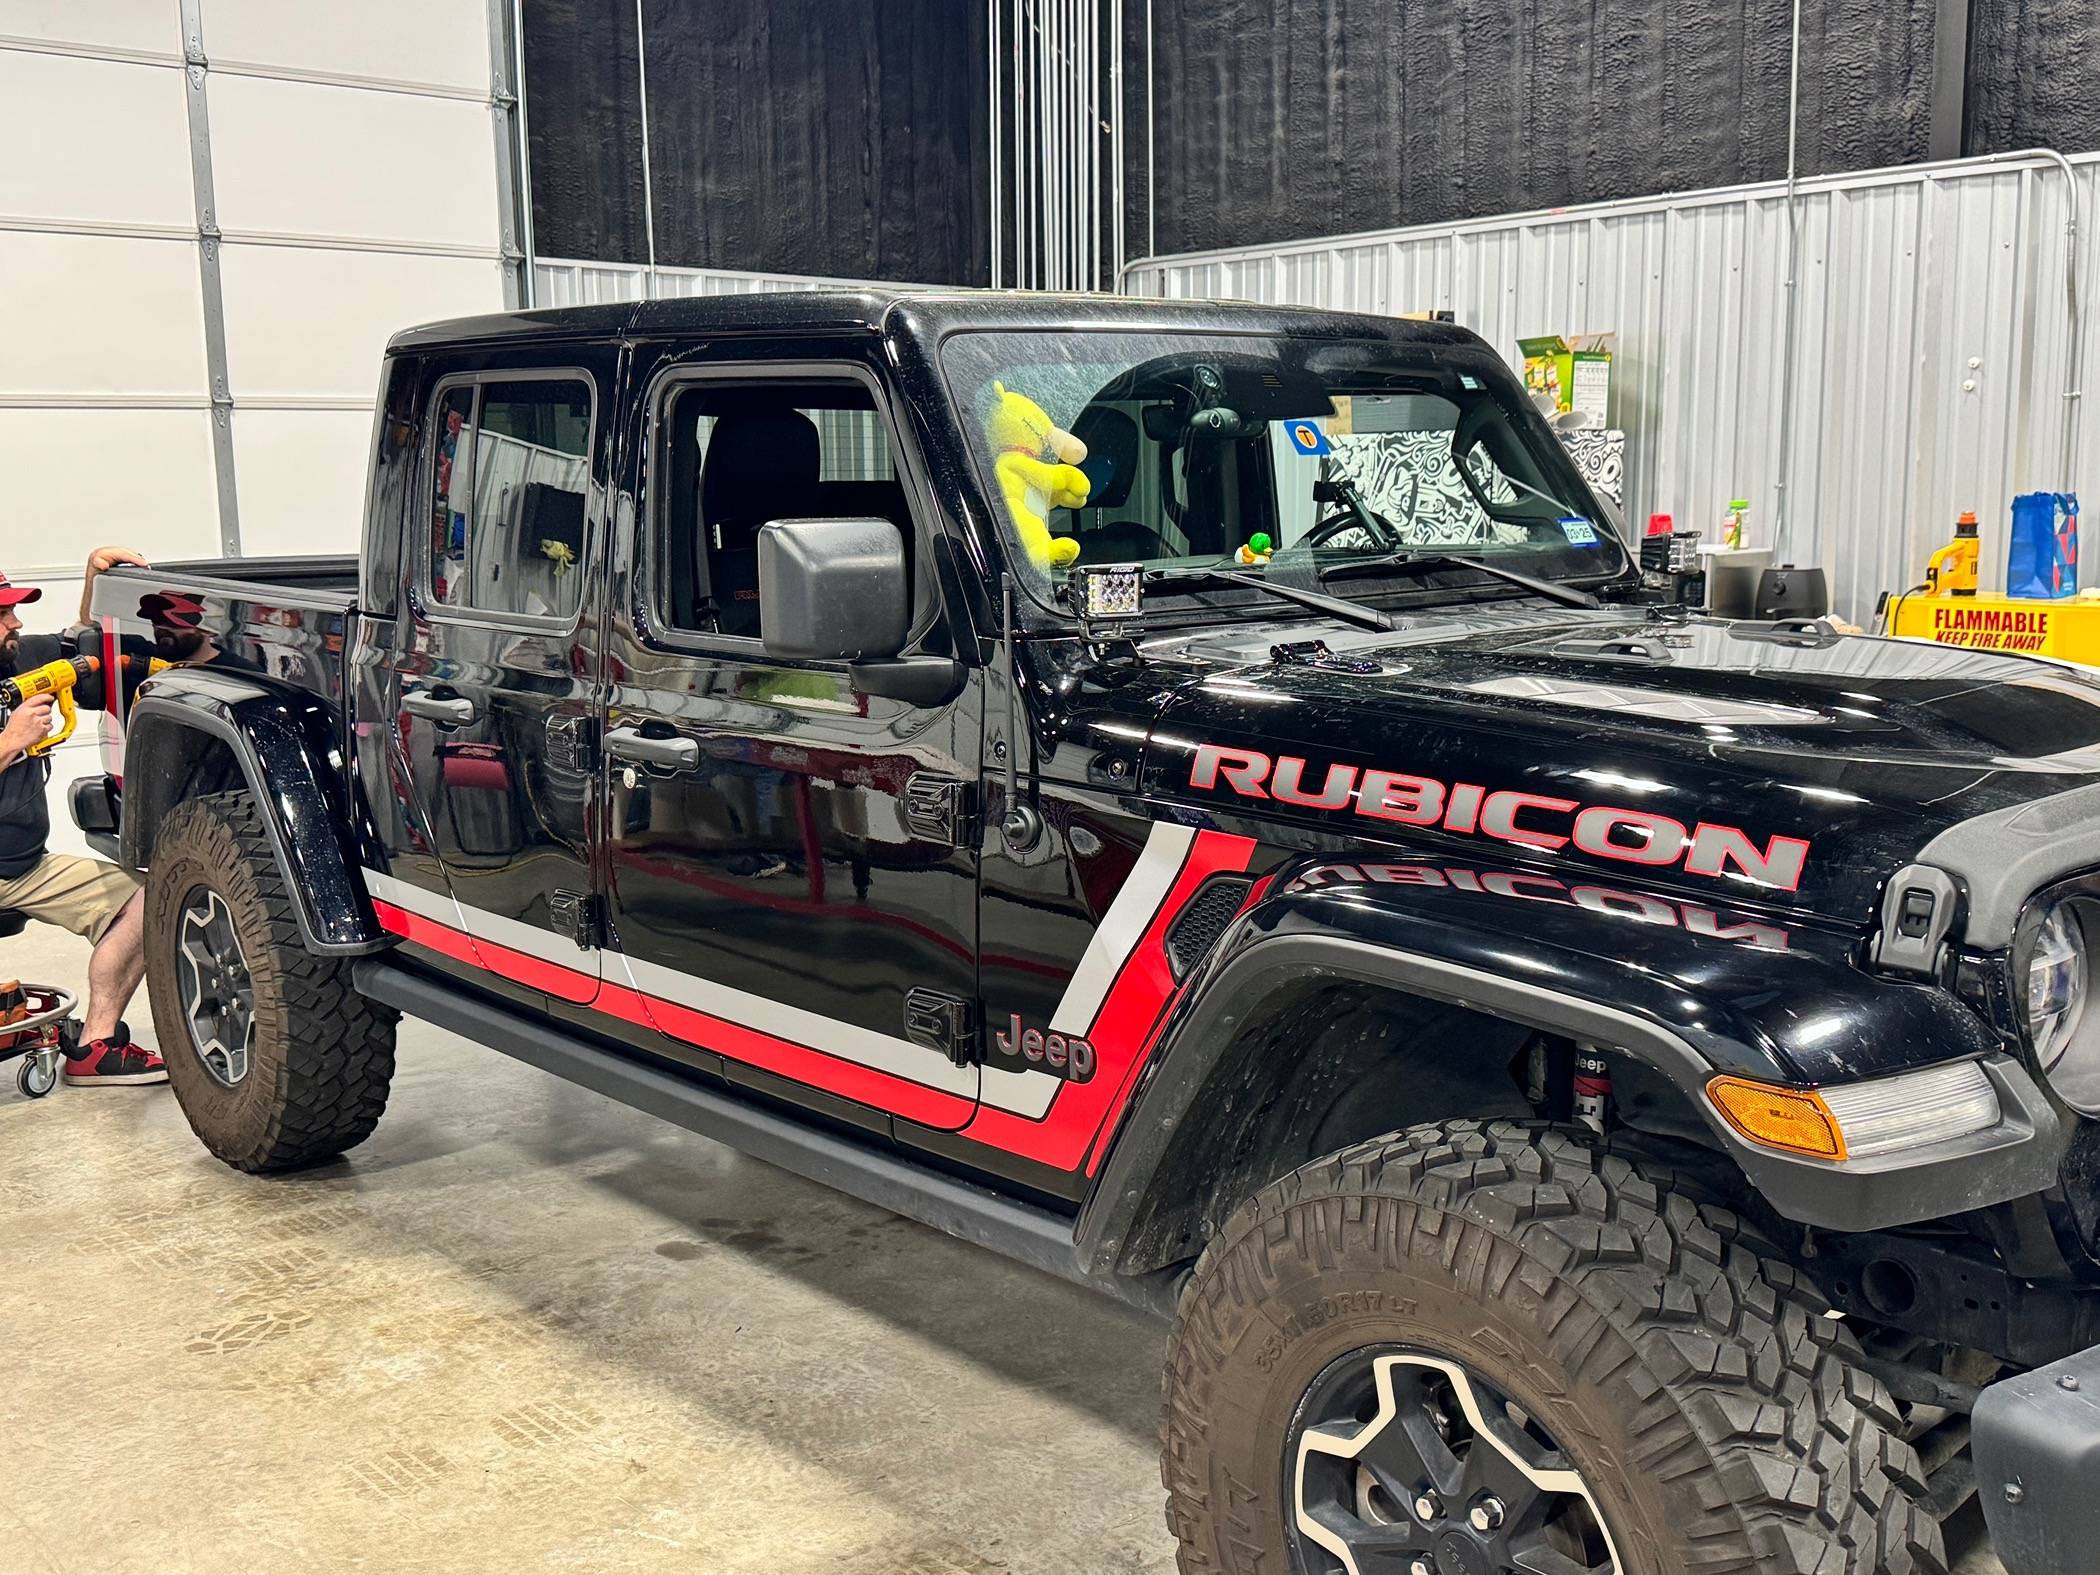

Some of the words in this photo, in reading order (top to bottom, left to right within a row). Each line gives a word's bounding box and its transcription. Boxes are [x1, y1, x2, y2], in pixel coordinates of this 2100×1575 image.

[1935, 608, 2048, 634] FLAMMABLE
[1935, 630, 1969, 646] KEEP
[1970, 632, 2001, 648] FIRE
[2001, 634, 2046, 651] AWAY
[1189, 743, 1811, 892] RUBICON
[996, 1012, 1094, 1081] Jeep
[1574, 1053, 1607, 1073] Jeep
